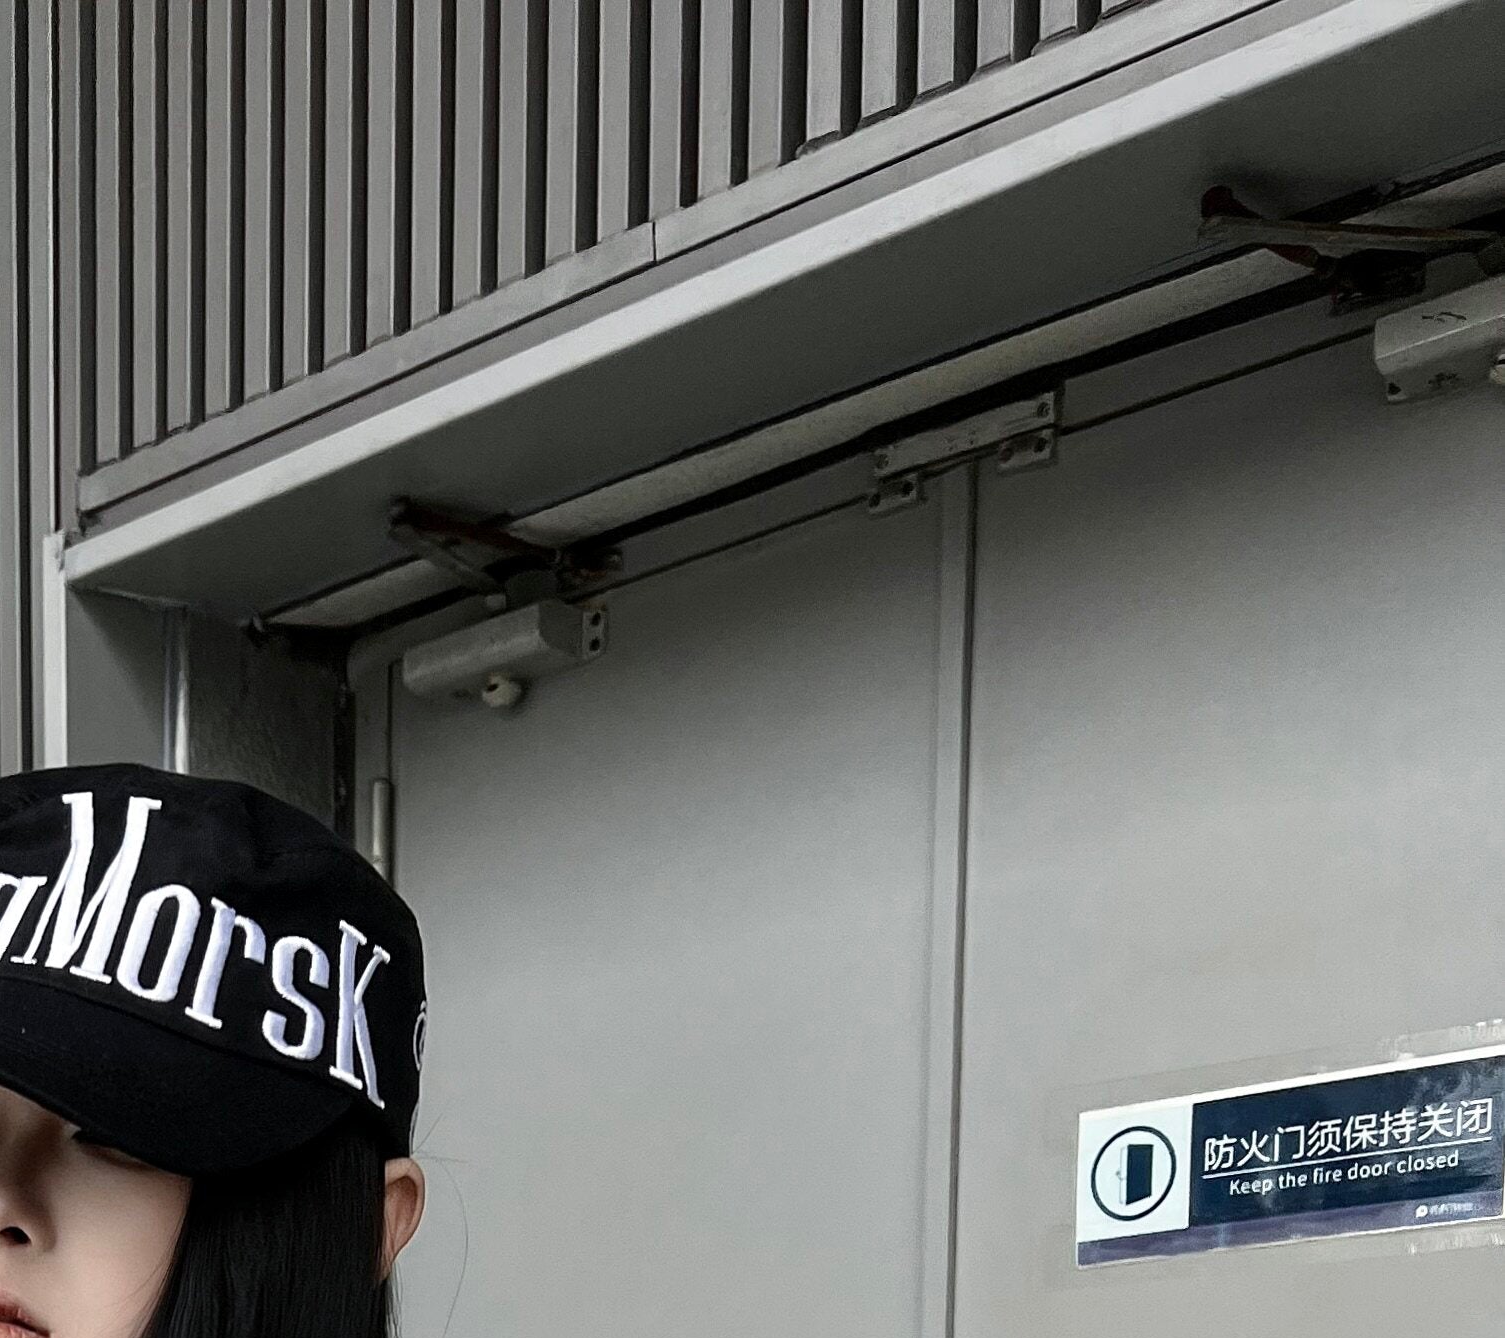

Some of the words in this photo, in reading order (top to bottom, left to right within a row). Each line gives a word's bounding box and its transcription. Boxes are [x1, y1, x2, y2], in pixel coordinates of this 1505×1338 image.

[1203, 1097, 1493, 1172] 防火门须保持关闭
[1229, 1178, 1274, 1196] Keep
[1278, 1171, 1308, 1190] the
[1313, 1166, 1343, 1185] fire
[1347, 1160, 1392, 1180] door
[1396, 1149, 1459, 1175] closed
